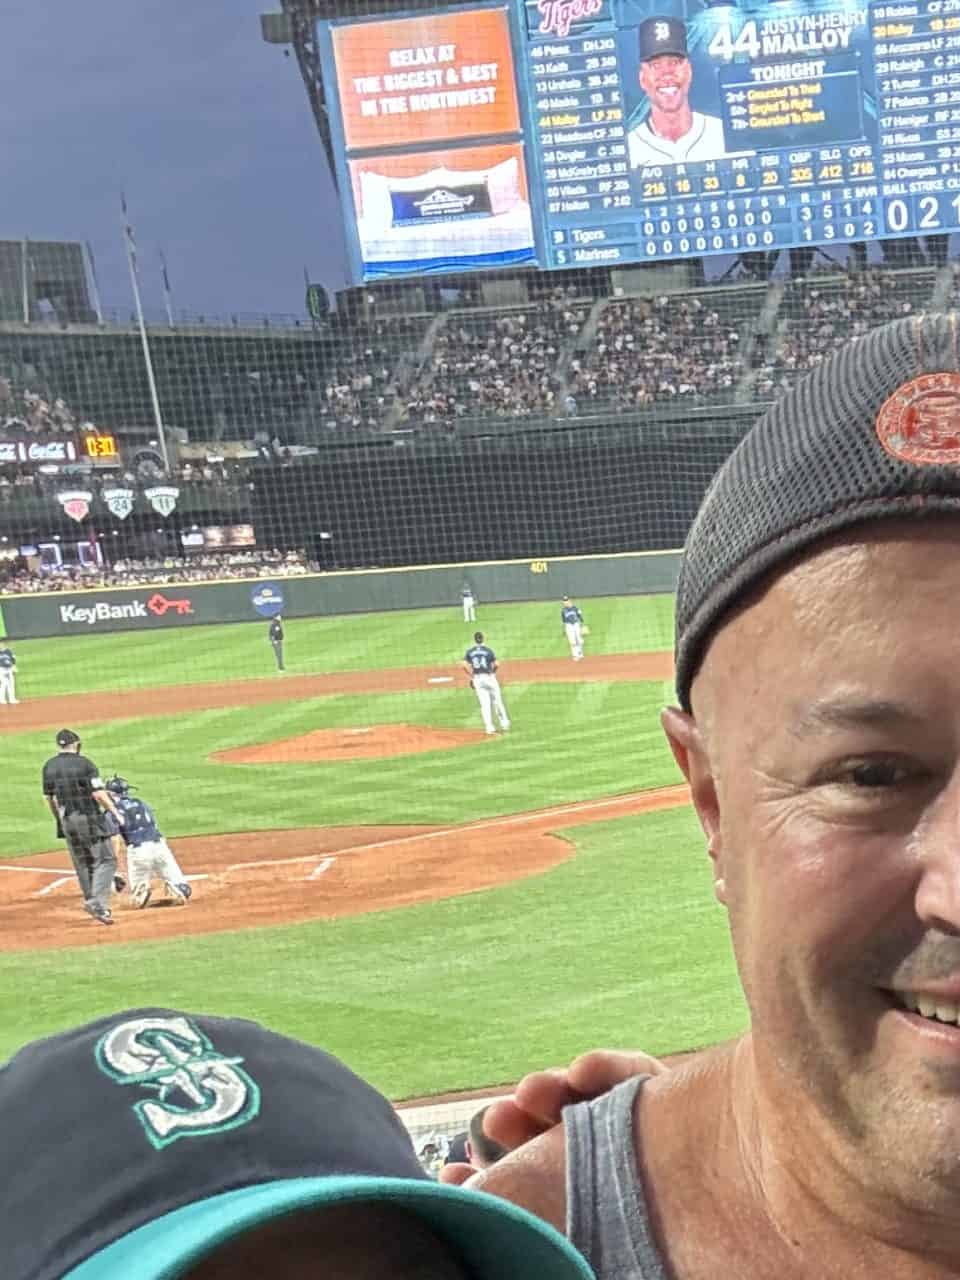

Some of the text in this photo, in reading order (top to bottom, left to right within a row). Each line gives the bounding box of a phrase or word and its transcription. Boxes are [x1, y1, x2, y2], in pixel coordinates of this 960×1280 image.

[760, 9, 868, 36] JUSTYN-HENRY
[708, 20, 760, 60] 44
[762, 27, 853, 56] MALLOY
[389, 44, 456, 68] RELAX AT
[751, 60, 826, 81] TONIGHT
[353, 63, 498, 93] THE BIGGEST & BEST
[360, 87, 496, 117] IN THE NORTHWEST
[883, 183, 908, 196] BALL
[909, 180, 944, 193] STRIKE
[572, 230, 606, 244] Tigers
[645, 222, 653, 234] 0
[661, 220, 670, 233] 0
[678, 219, 687, 232] 0
[695, 217, 704, 230] 0
[712, 215, 720, 228] 3
[729, 213, 737, 226] 0
[745, 212, 754, 225] 0
[762, 211, 771, 224] 0
[802, 208, 811, 220] 3
[824, 205, 832, 218] 5
[844, 204, 851, 216] 1
[863, 202, 871, 214] 4
[887, 199, 908, 231] 0
[920, 196, 941, 229] 2
[574, 248, 621, 262] Mariners
[647, 242, 655, 255] 0
[663, 240, 672, 253] 0
[680, 239, 689, 251] 0
[697, 237, 705, 249] 0
[713, 235, 722, 248] 0
[731, 234, 739, 247] 1
[747, 233, 756, 246] 0
[764, 231, 773, 244] 0
[805, 228, 812, 240] 1
[824, 226, 833, 238] 3
[845, 224, 854, 236] 0
[864, 222, 873, 235] 2
[60, 600, 148, 624] KeyBank
